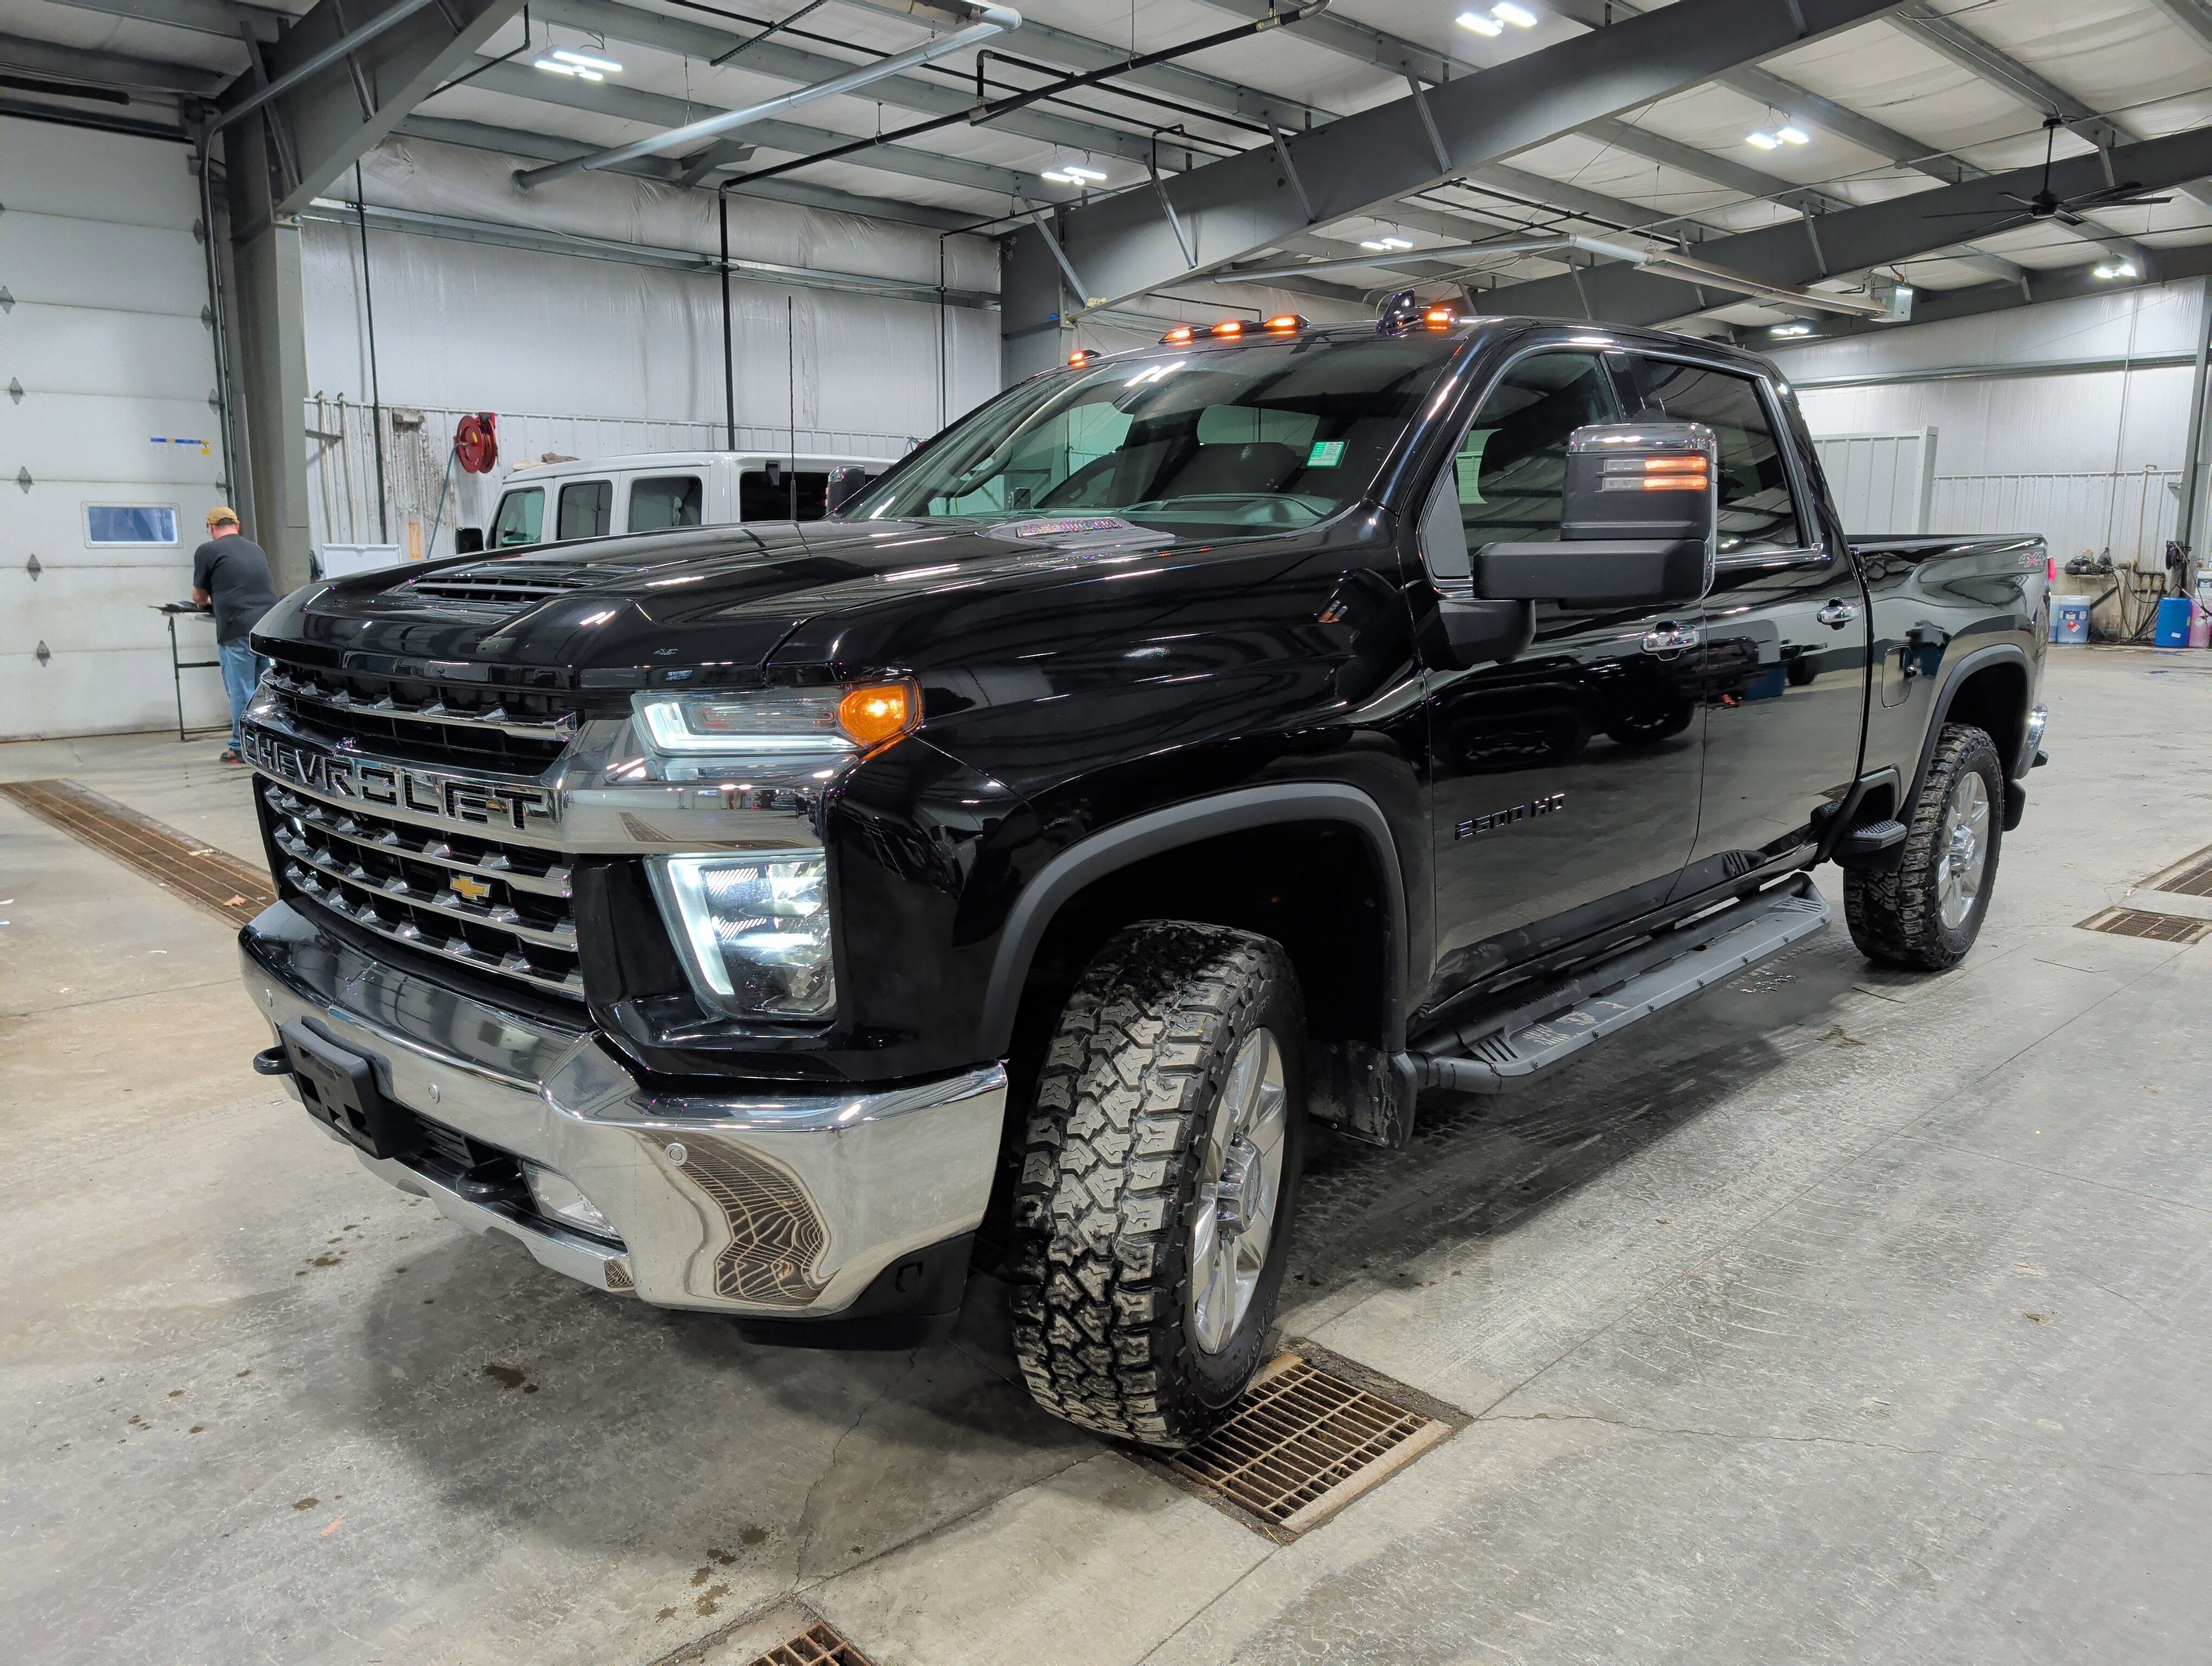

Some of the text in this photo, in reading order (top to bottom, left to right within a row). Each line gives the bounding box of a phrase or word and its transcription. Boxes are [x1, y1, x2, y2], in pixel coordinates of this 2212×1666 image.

[242, 727, 543, 831] CHEVROLET
[1455, 793, 1565, 840] 2500 HD
